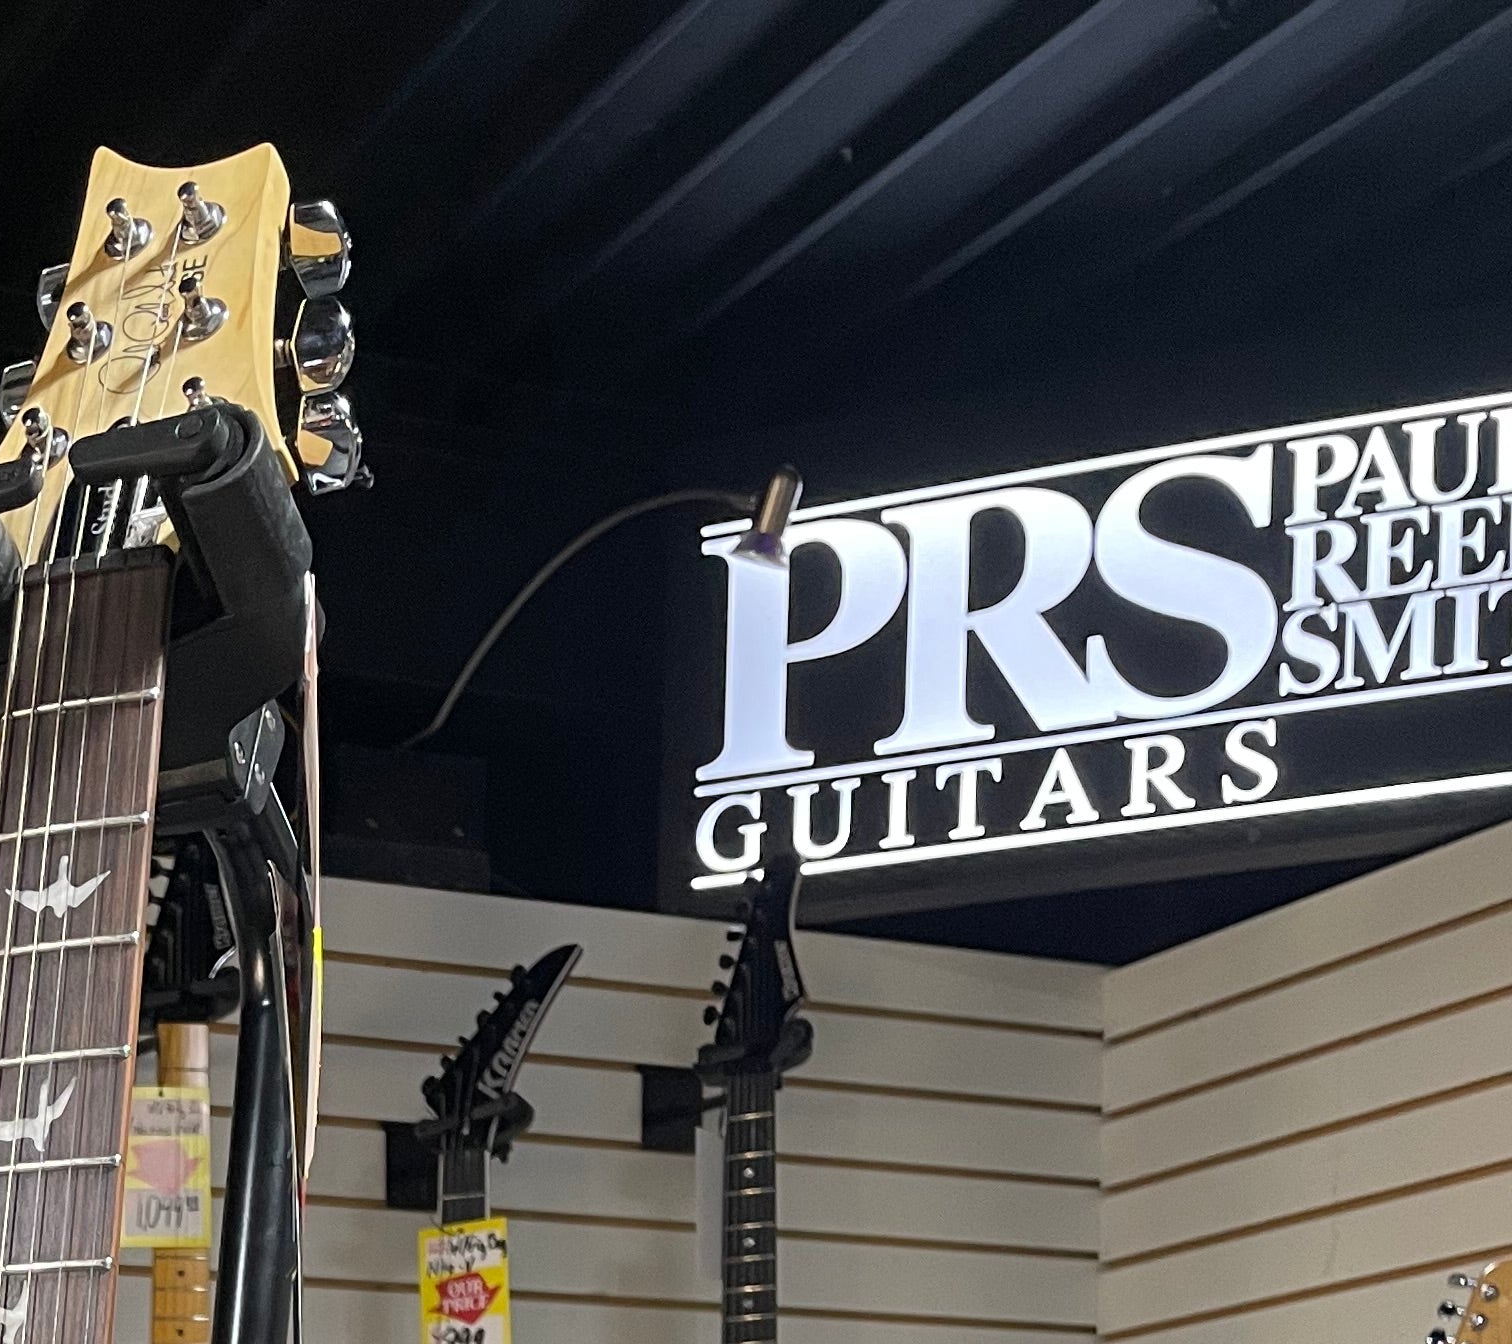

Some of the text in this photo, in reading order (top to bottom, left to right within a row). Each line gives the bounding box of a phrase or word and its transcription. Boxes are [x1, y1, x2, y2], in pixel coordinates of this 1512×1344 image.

[696, 444, 1277, 782] PRS
[1284, 495, 1512, 612] REE
[695, 719, 1279, 872] GUITARS
